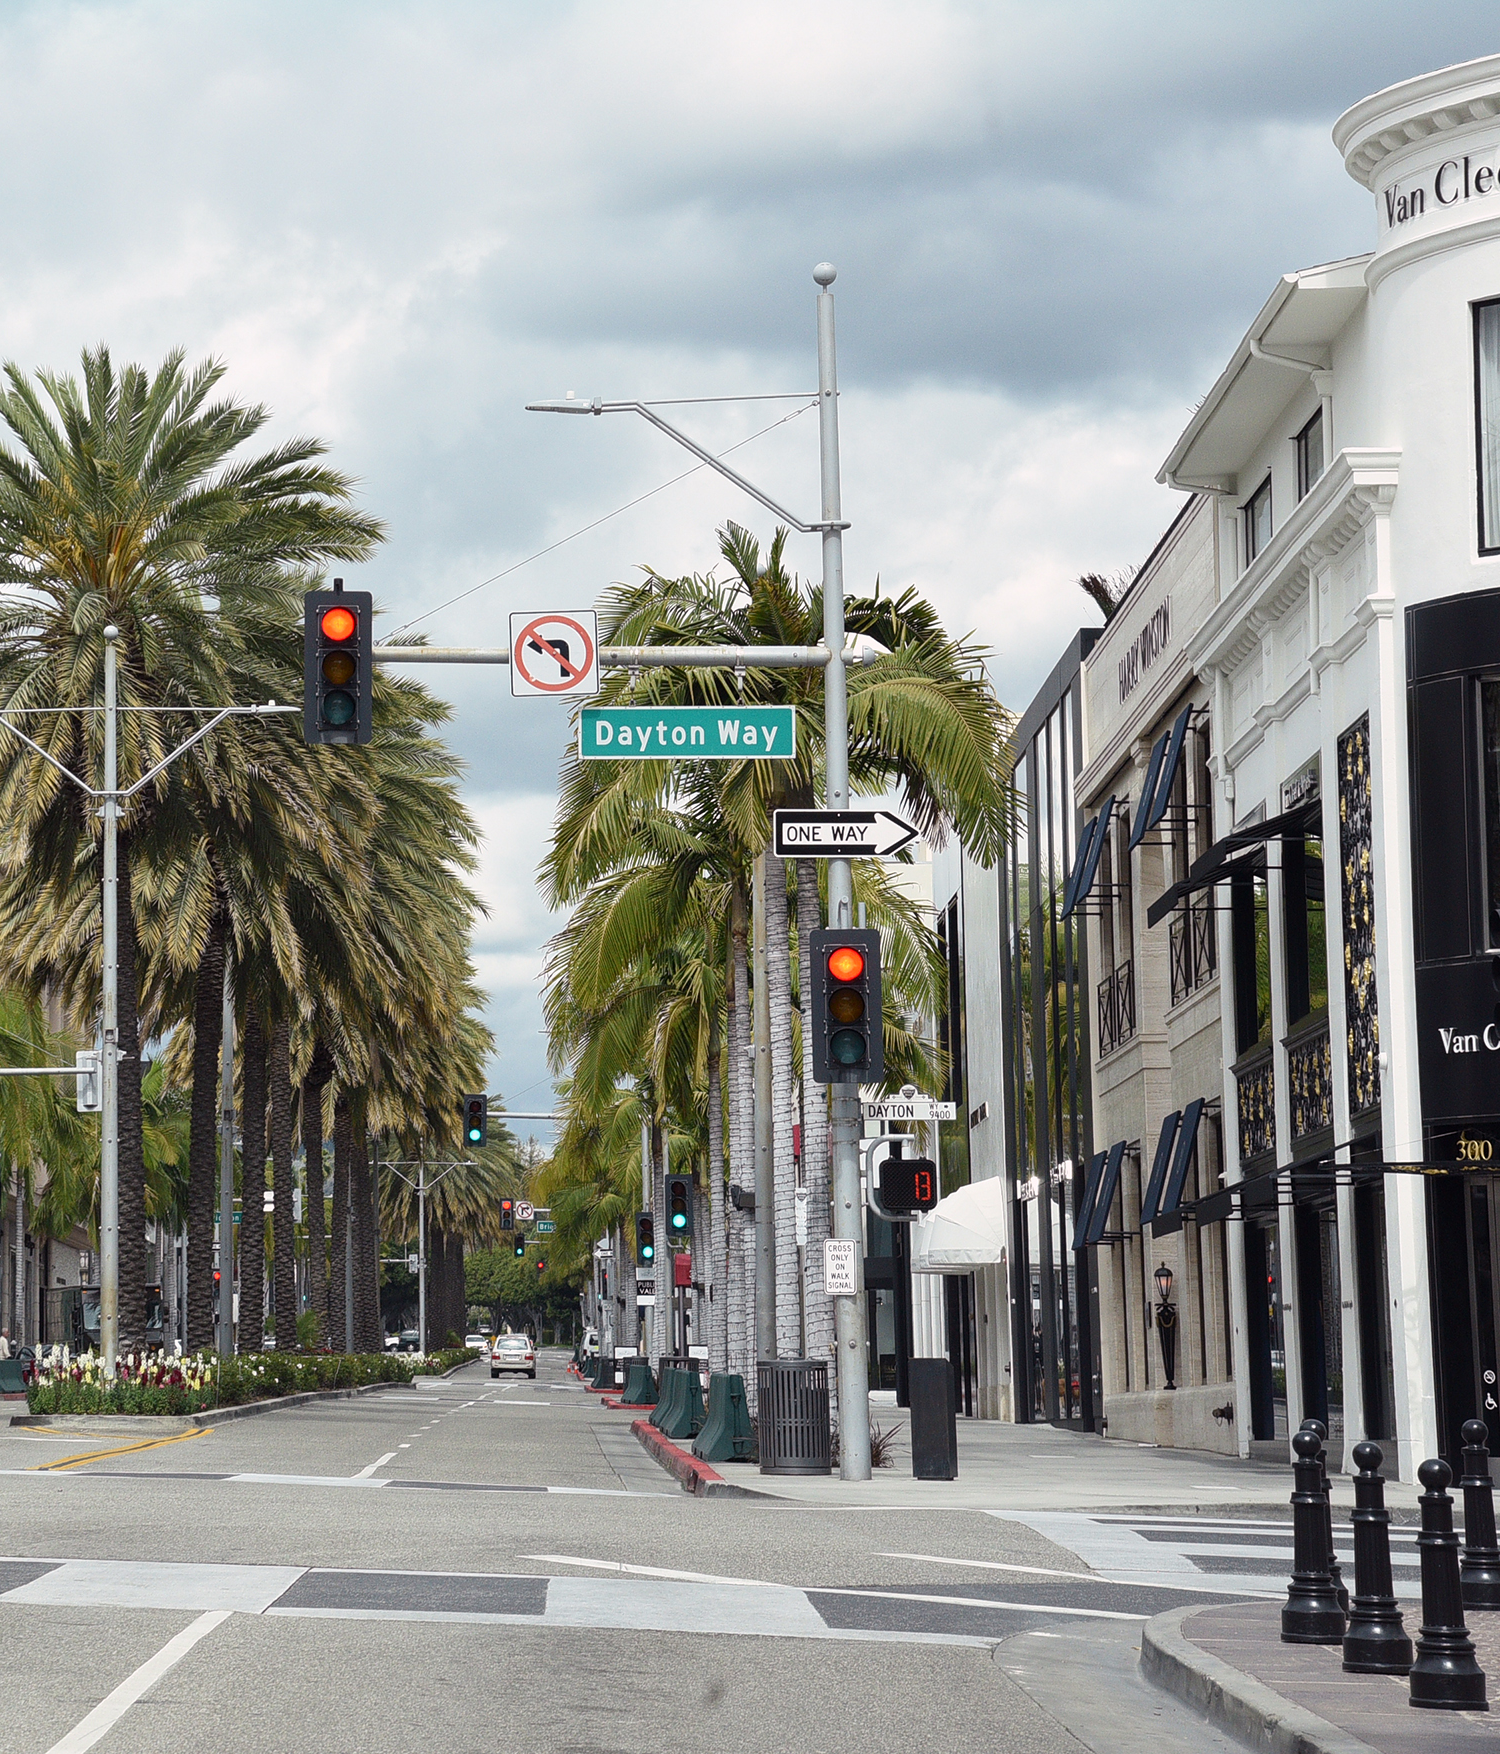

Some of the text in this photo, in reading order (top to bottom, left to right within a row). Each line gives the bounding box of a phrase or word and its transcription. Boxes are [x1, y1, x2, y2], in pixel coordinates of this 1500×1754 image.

[1384, 156, 1500, 228] Van Cle
[595, 719, 778, 752] Dayton Way
[786, 826, 868, 842] ONE WAY
[1438, 1027, 1479, 1054] Van
[868, 1104, 914, 1118] DAYTON
[929, 1110, 951, 1119] 9400
[1456, 1140, 1493, 1161] 300
[915, 1171, 932, 1201] 13
[828, 1244, 852, 1252] CROSS
[830, 1253, 849, 1262] ONLY
[831, 1272, 850, 1280] WALK
[828, 1281, 853, 1289] SIGNAL
